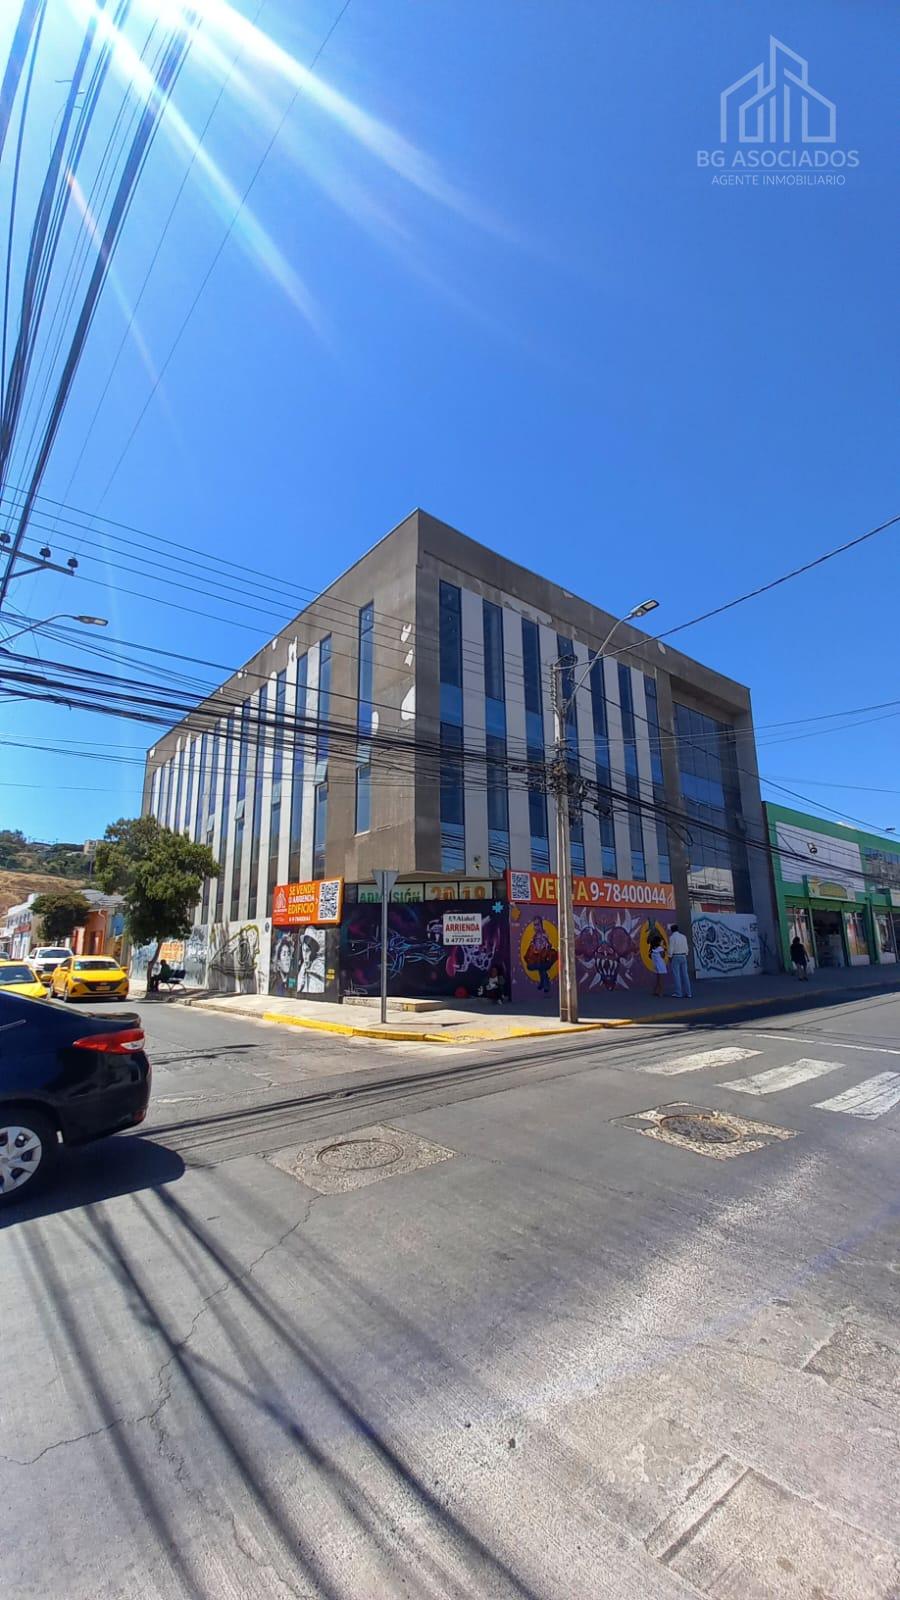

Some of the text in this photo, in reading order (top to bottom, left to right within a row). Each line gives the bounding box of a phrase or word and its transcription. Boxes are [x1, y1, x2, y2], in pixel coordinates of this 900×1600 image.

[288, 883, 316, 896] SE VENDE
[532, 876, 667, 905] VEA 9-78400044
[287, 902, 315, 915] EDIFICIO
[445, 922, 480, 932] ARRIENDA
